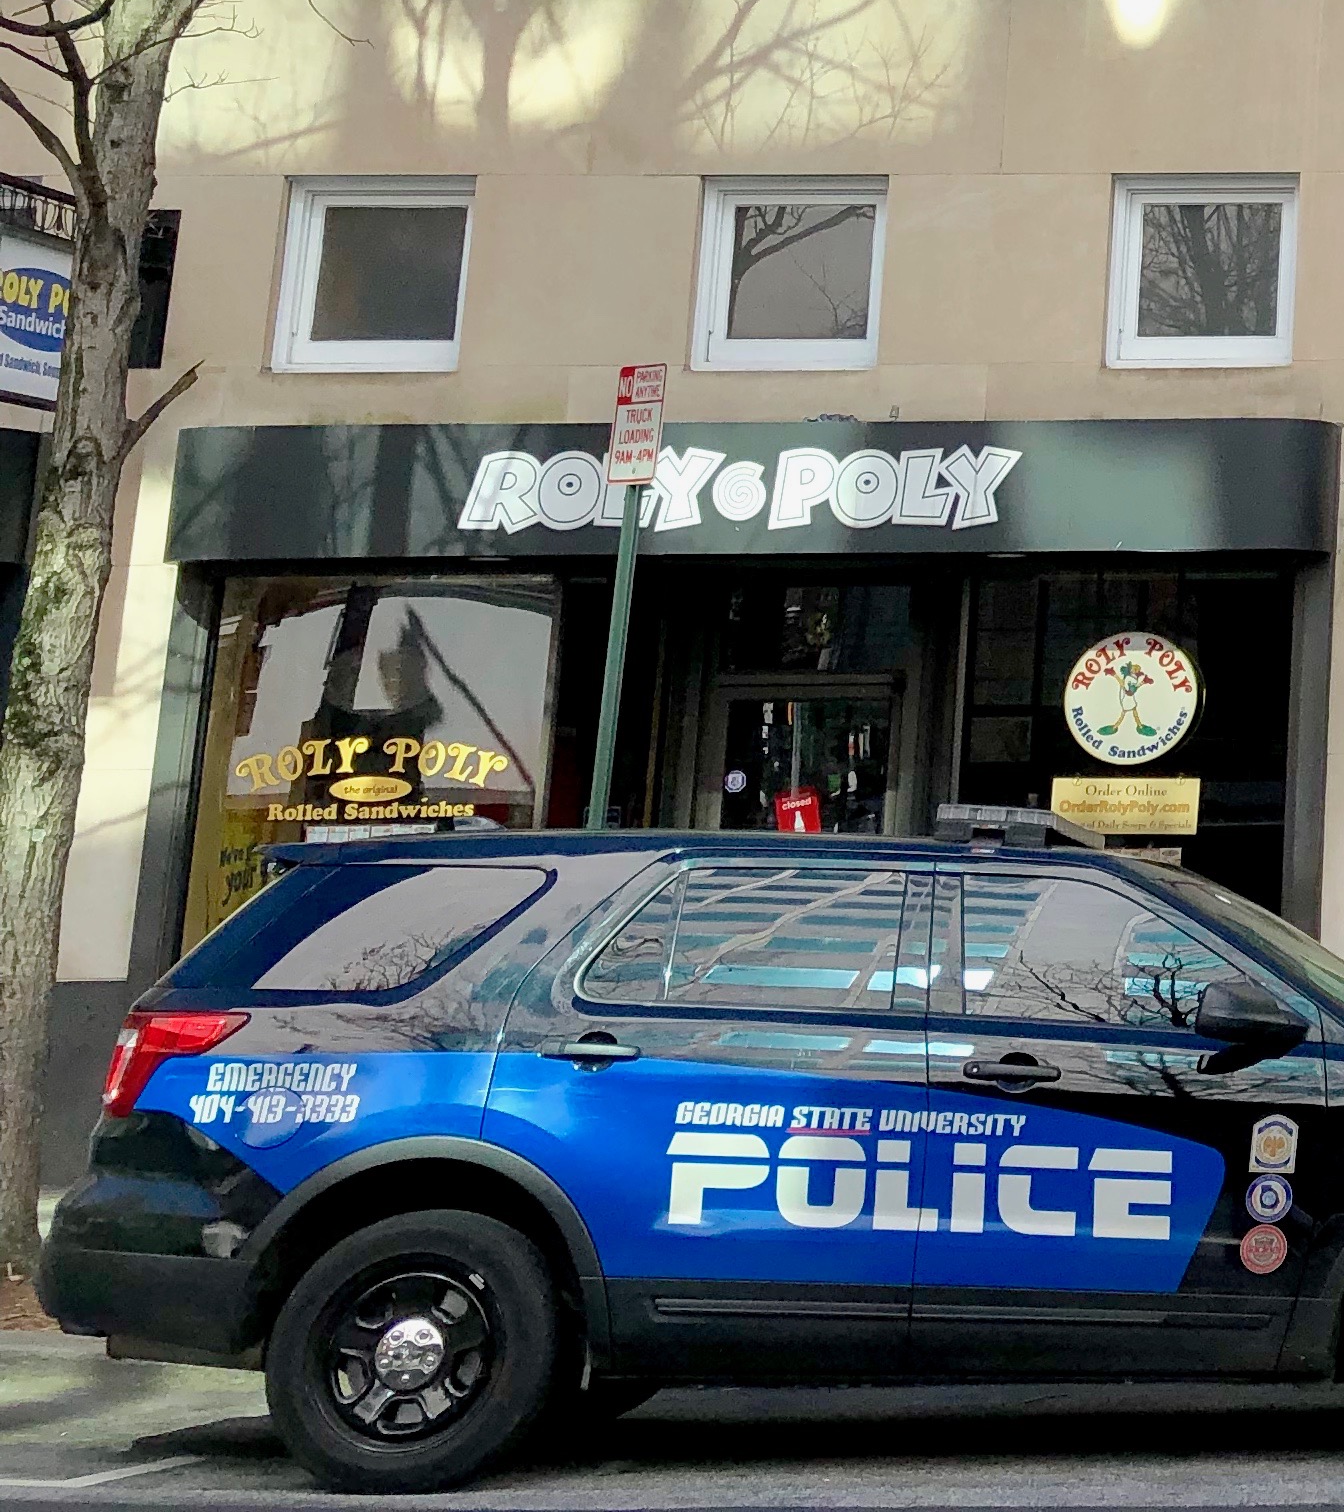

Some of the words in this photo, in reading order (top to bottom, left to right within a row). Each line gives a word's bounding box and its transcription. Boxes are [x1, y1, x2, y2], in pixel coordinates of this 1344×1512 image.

[0, 268, 44, 310] OLY
[618, 375, 633, 398] NO
[635, 368, 663, 384] PARKING
[635, 384, 661, 400] ANYTIME
[626, 407, 654, 424] TRUCK
[618, 427, 655, 445] LOADING
[767, 443, 1024, 532] POLY
[1072, 637, 1131, 691] ROLY
[1144, 637, 1193, 694] POLY
[1071, 705, 1104, 751] Rolled
[1107, 709, 1189, 759] Sandwiches
[235, 737, 370, 793] ROLY
[383, 737, 510, 788] POLY
[782, 796, 812, 811] closed
[1085, 784, 1122, 797] Order
[1125, 784, 1168, 797] Online
[267, 803, 338, 821] Rolled
[344, 797, 475, 820] Sandwiches
[1059, 800, 1190, 816] OrderRolyPoly.com
[206, 1062, 358, 1092] EMERGENCY
[188, 1093, 361, 1124] 404-413-3333
[675, 1101, 784, 1129] GEORGIA
[790, 1106, 873, 1131] STATE
[879, 1108, 1026, 1137] UNIVERSITY
[665, 1131, 1174, 1241] POLICE
